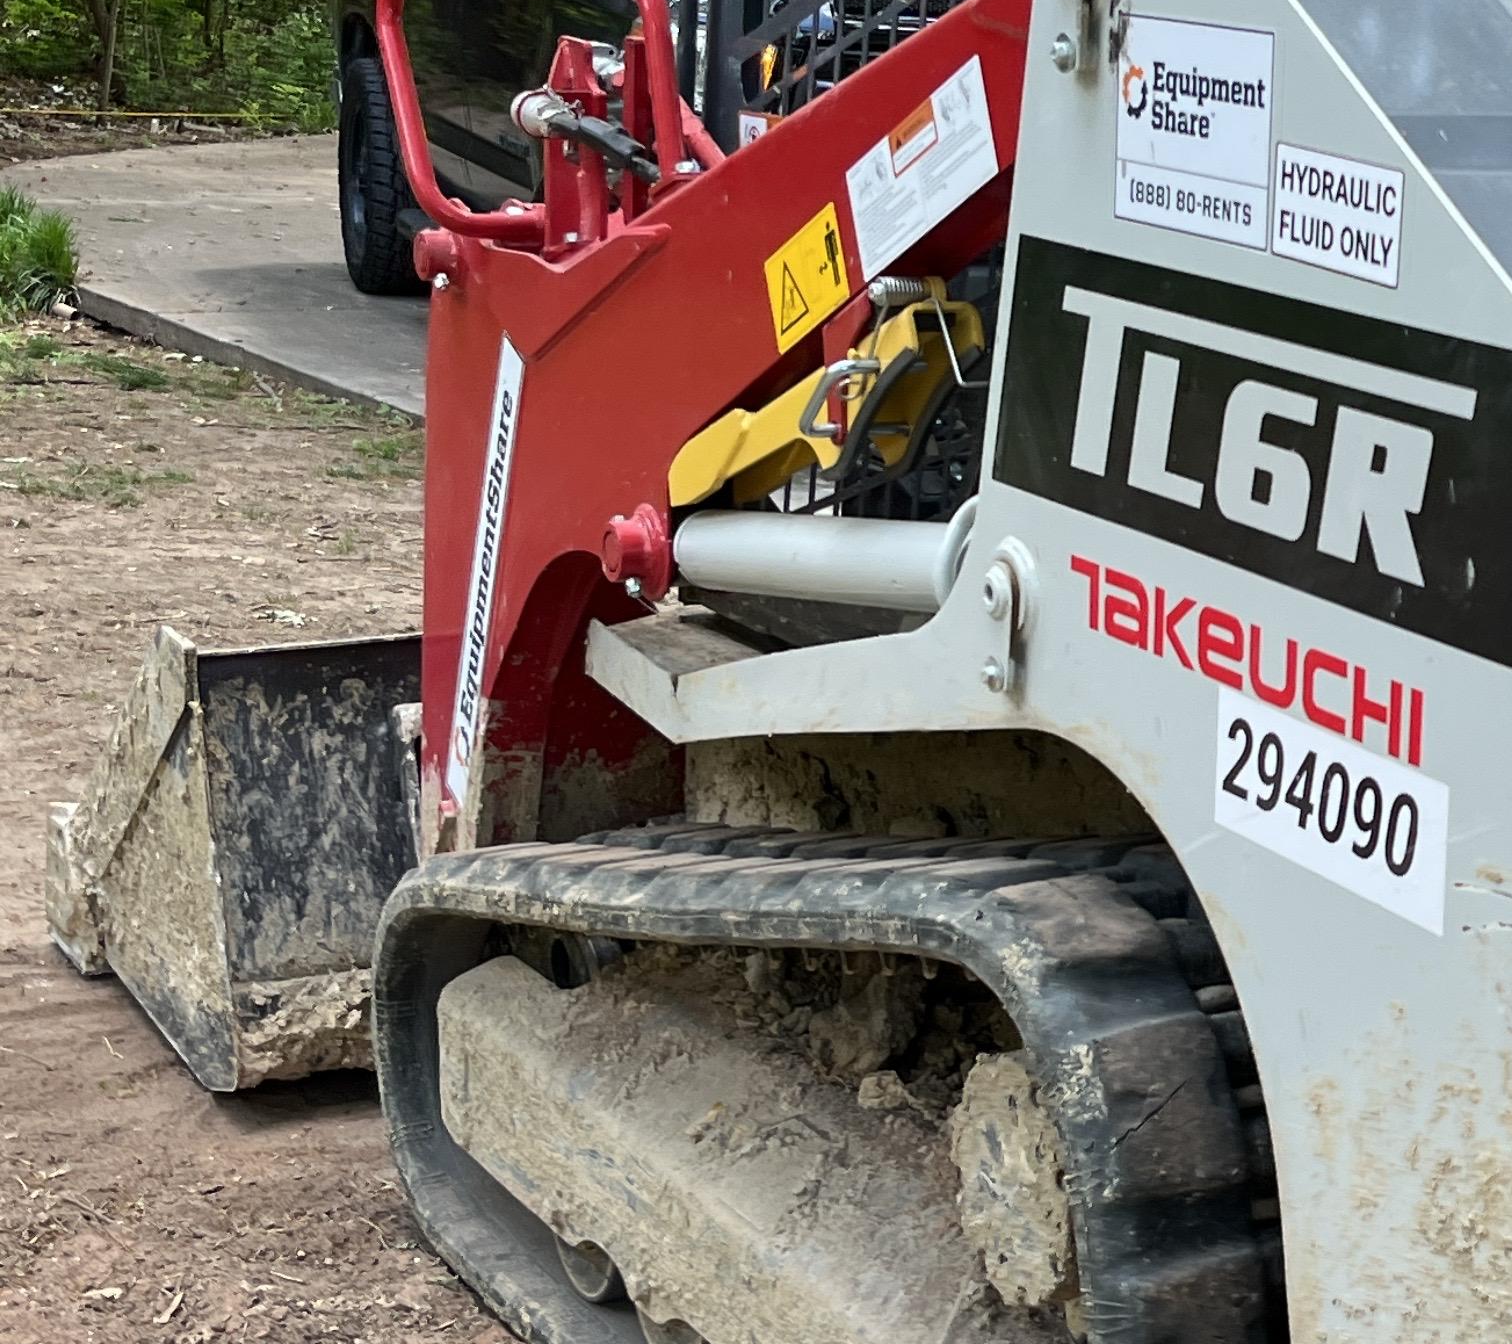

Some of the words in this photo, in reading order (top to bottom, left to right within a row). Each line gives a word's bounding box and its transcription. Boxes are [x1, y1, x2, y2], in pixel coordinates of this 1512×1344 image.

[1152, 61, 1266, 109] Equipment
[1151, 100, 1211, 139] Share
[1129, 178, 1171, 210] (888)
[1175, 189, 1252, 227] 80-RENTS
[1280, 159, 1397, 217] HYDRAULIC
[1279, 209, 1334, 251] FLUID
[1339, 226, 1394, 269] ONLY
[1062, 284, 1478, 588] TL6R
[458, 389, 514, 728] EquipmentShare
[1221, 717, 1420, 877] 294090
